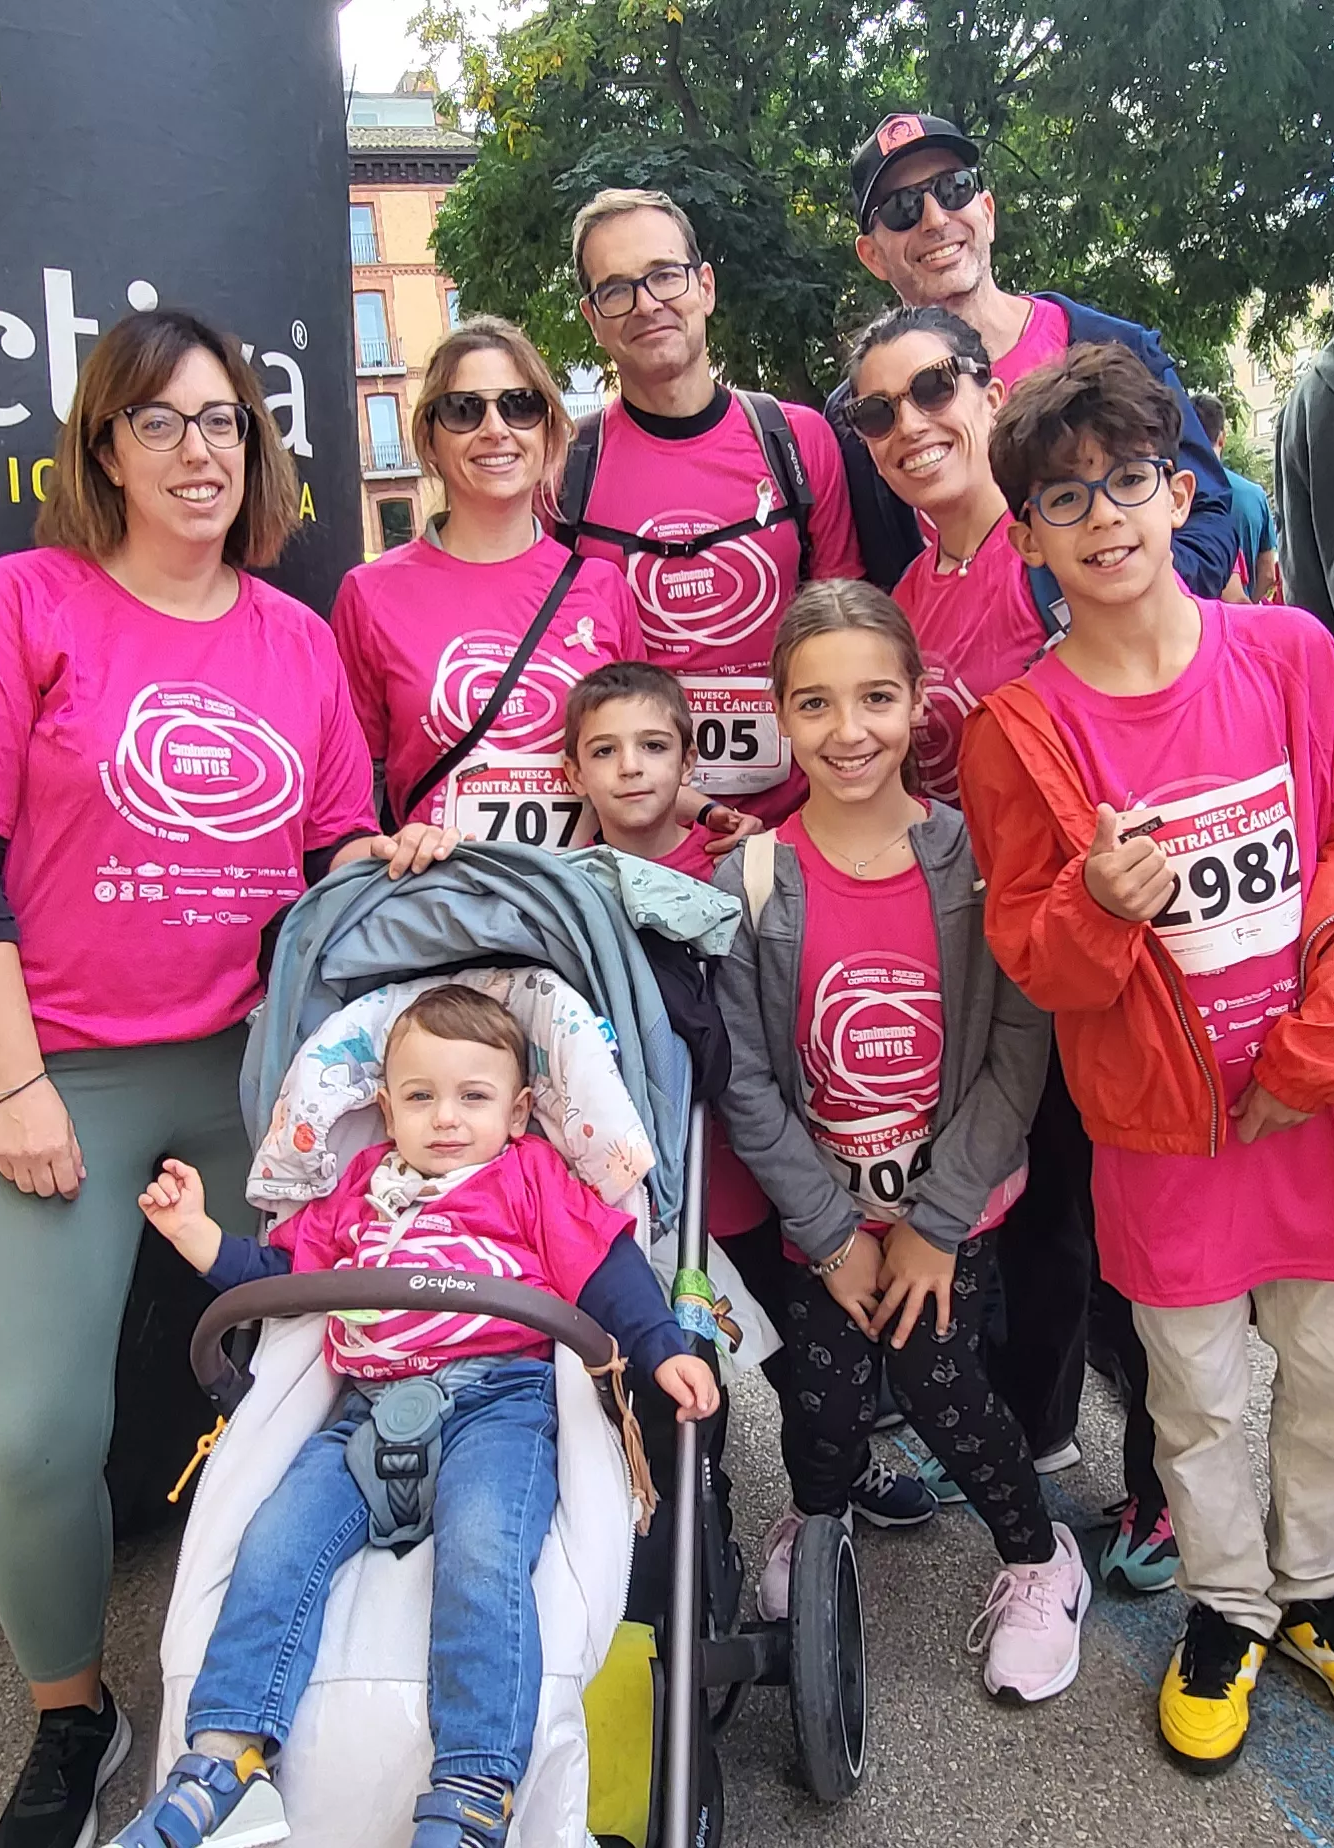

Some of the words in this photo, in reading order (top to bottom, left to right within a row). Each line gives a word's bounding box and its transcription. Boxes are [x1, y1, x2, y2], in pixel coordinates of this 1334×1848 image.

[661, 567, 715, 584] Caminemos
[668, 580, 713, 600] JUNTOS
[693, 692, 731, 700] HUESCA
[705, 700, 721, 712] EL
[723, 699, 773, 712] CÁNCER
[696, 718, 759, 762] 05
[172, 759, 230, 776] JUNTOS
[509, 769, 552, 780] HUESCA
[463, 780, 523, 794] CONTRA
[526, 780, 541, 793] EL
[543, 778, 574, 794] CÁN
[478, 801, 583, 848] 707
[1194, 804, 1246, 830] HUESCA
[1159, 832, 1212, 856] NTRA
[1212, 827, 1235, 842] EL
[1237, 801, 1287, 835] CÁNCER
[1150, 828, 1301, 928] 2982
[849, 1026, 916, 1043] Caminemos
[855, 1040, 913, 1060] JUNTOS
[814, 1132, 870, 1156] CONTRA
[872, 1143, 890, 1156] EL
[853, 1128, 900, 1145] HUESCA
[833, 1140, 933, 1202] 704
[428, 1275, 476, 1294] cybex
